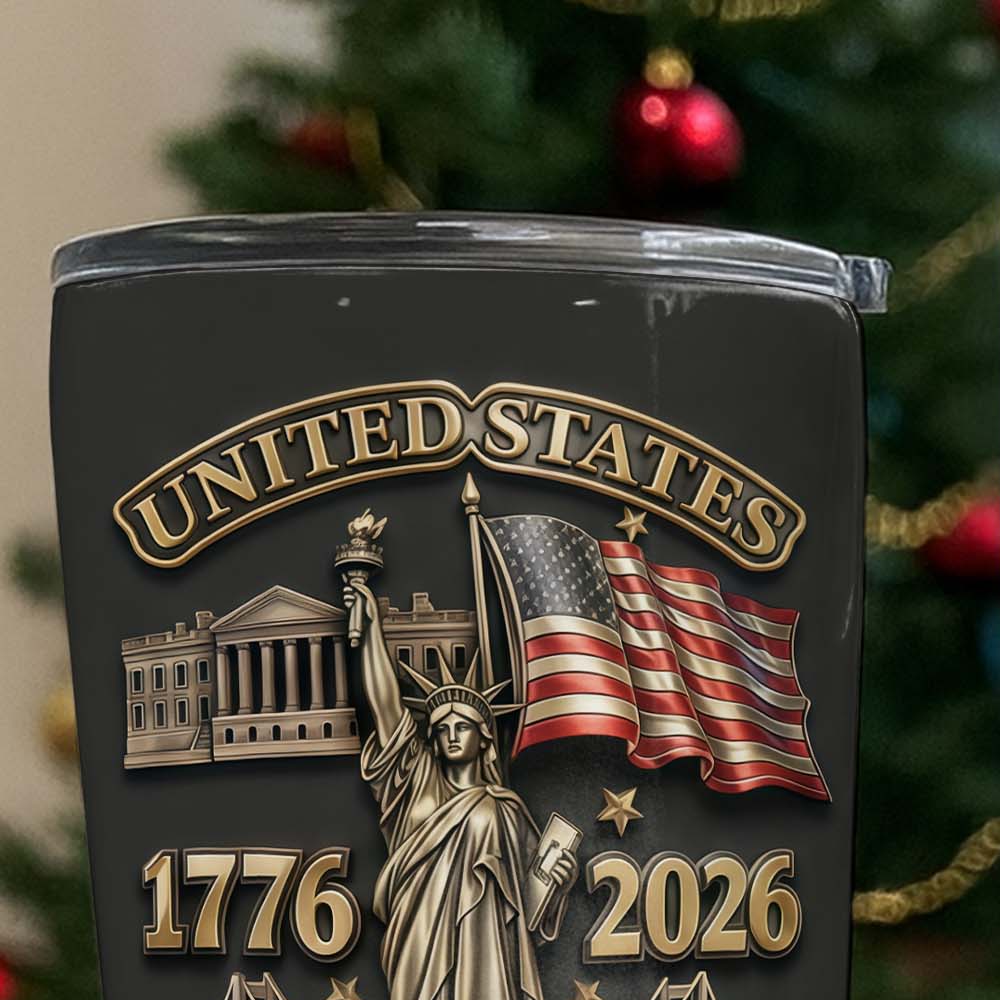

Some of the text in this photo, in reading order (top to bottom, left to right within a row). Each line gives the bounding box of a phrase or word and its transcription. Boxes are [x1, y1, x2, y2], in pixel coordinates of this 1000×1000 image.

[133, 394, 787, 556] UNITED STATES
[143, 850, 357, 957] 1776
[584, 853, 800, 959] 2026
